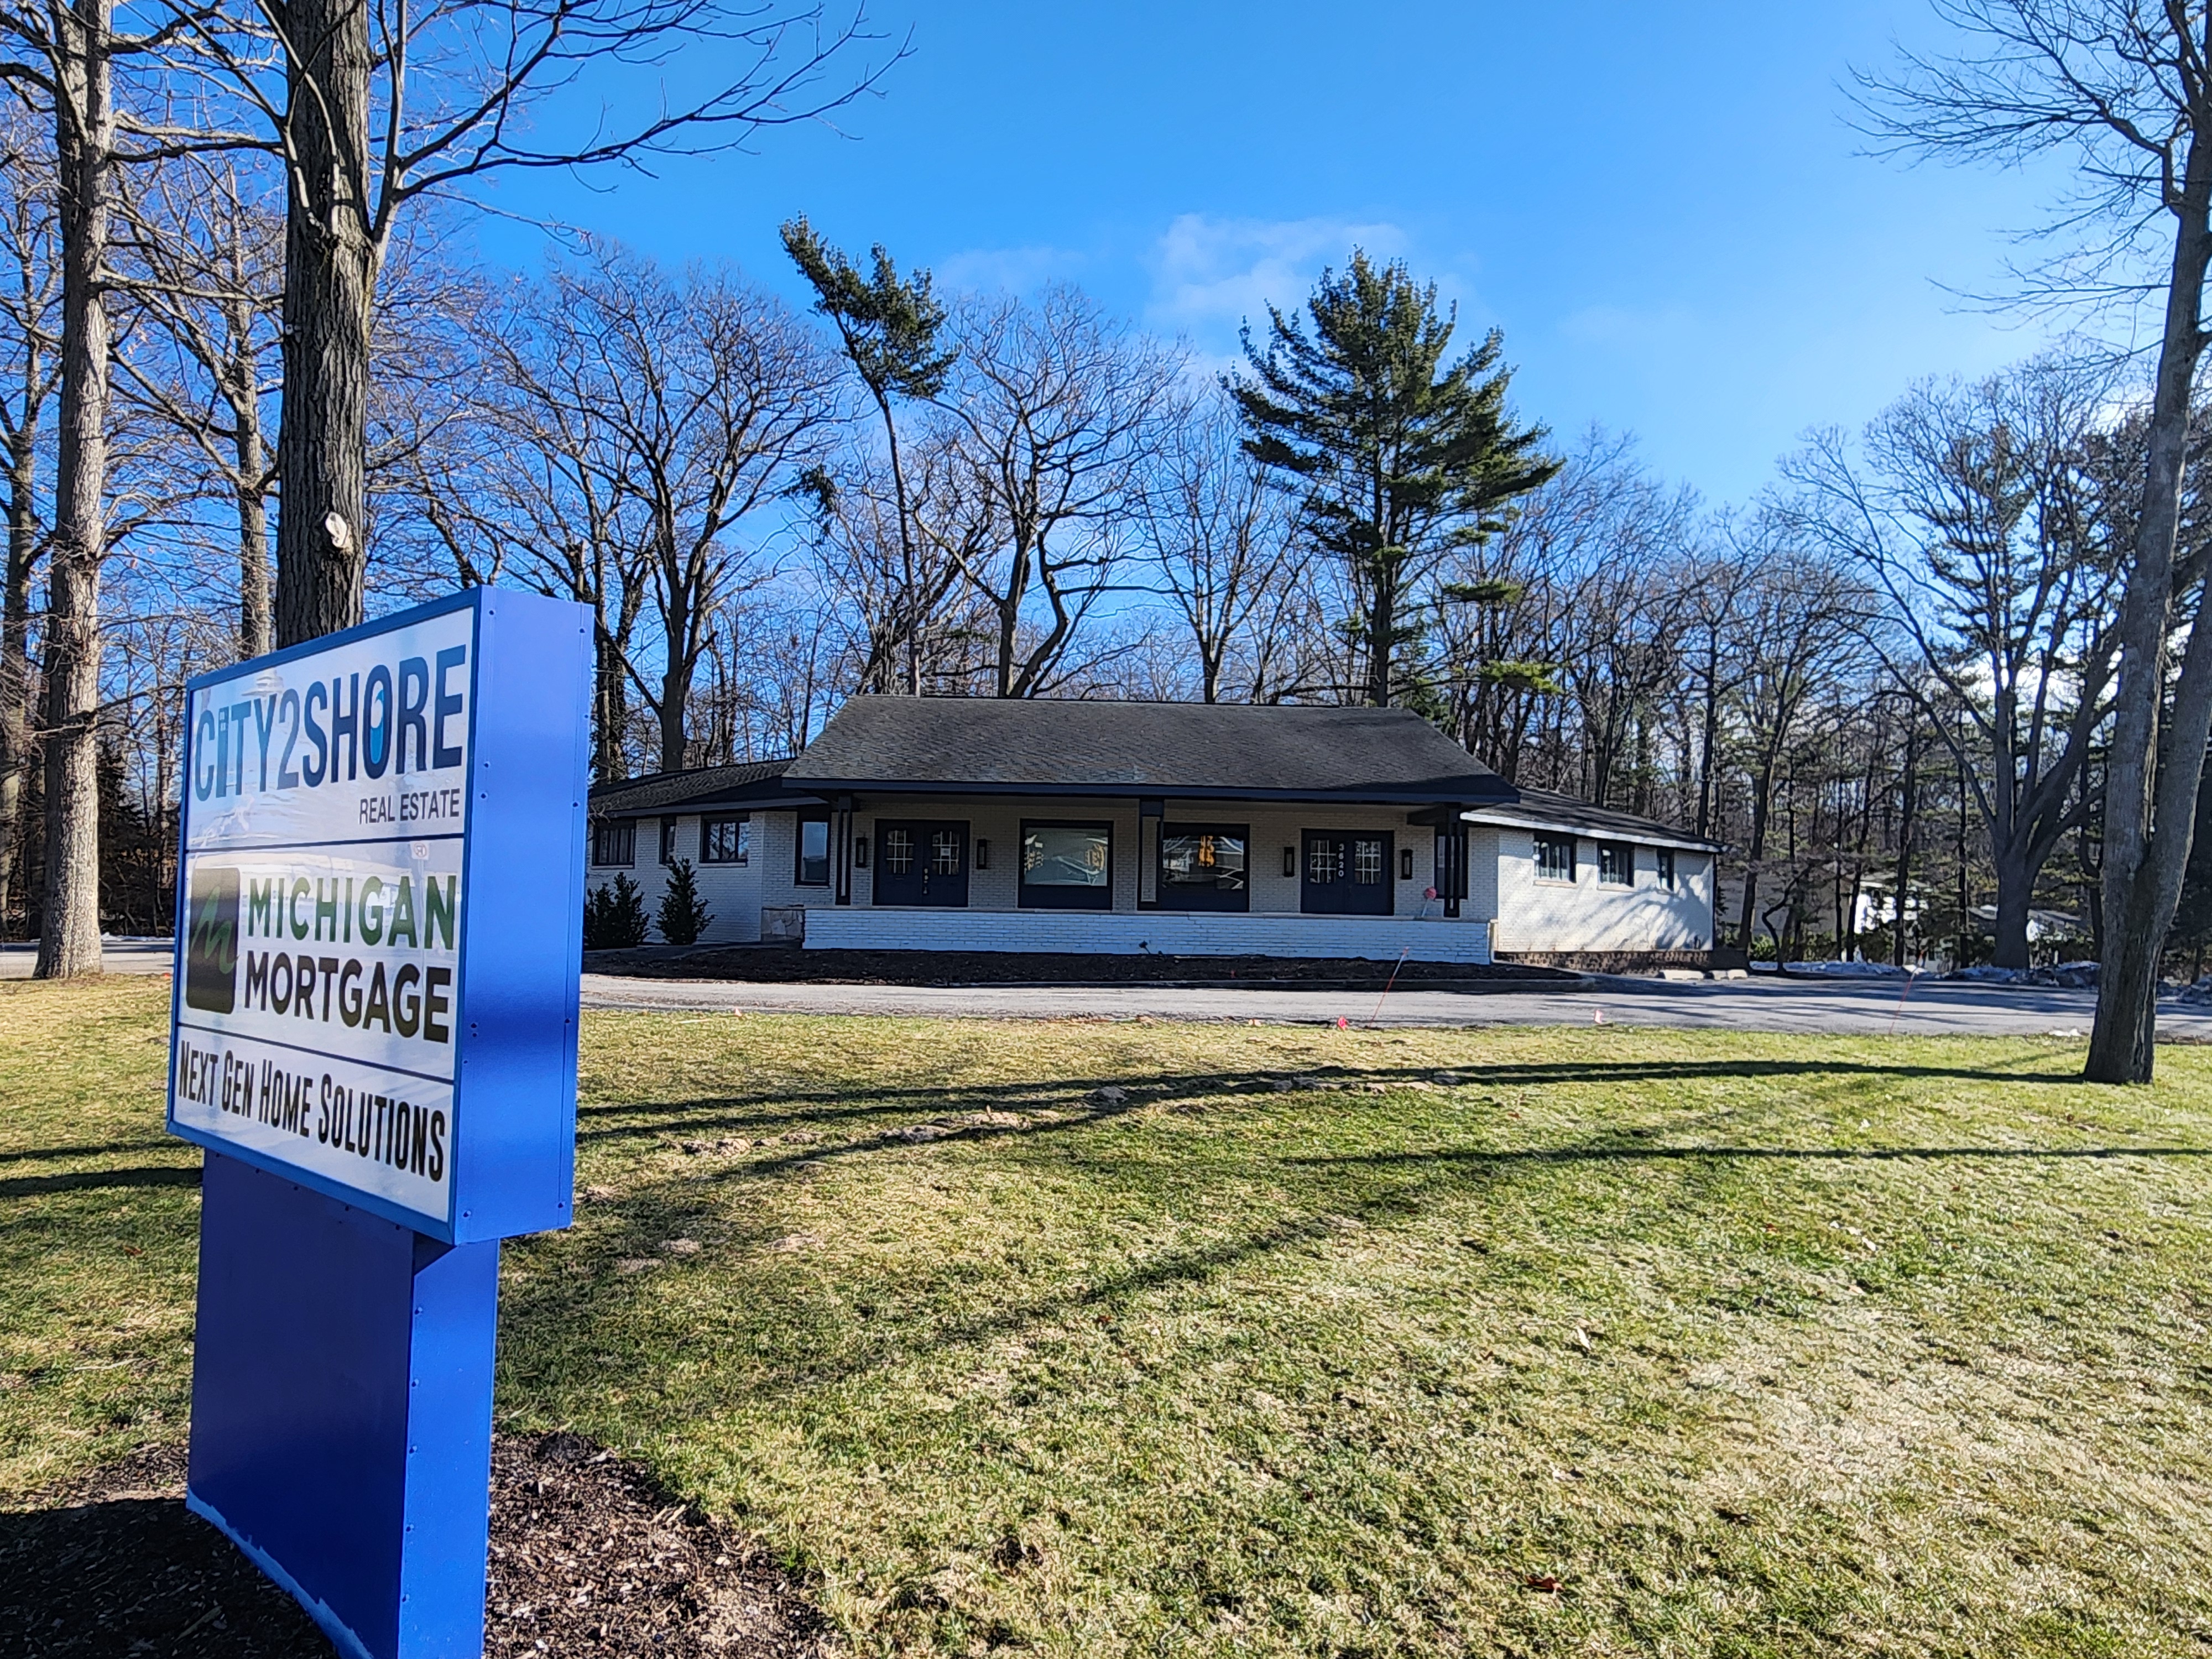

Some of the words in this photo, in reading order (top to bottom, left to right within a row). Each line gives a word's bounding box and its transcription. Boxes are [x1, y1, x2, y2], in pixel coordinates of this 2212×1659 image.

[195, 644, 466, 802] CITY2SHORE
[359, 794, 395, 825] REAL
[400, 788, 460, 822] ESTATE
[247, 875, 457, 950] MICHIGAN
[244, 950, 451, 1044] MORTGAGE
[178, 1040, 219, 1107] NEXT
[221, 1050, 255, 1119] GEN
[258, 1058, 314, 1138] HOME
[317, 1073, 446, 1182] SOLUTIONS
